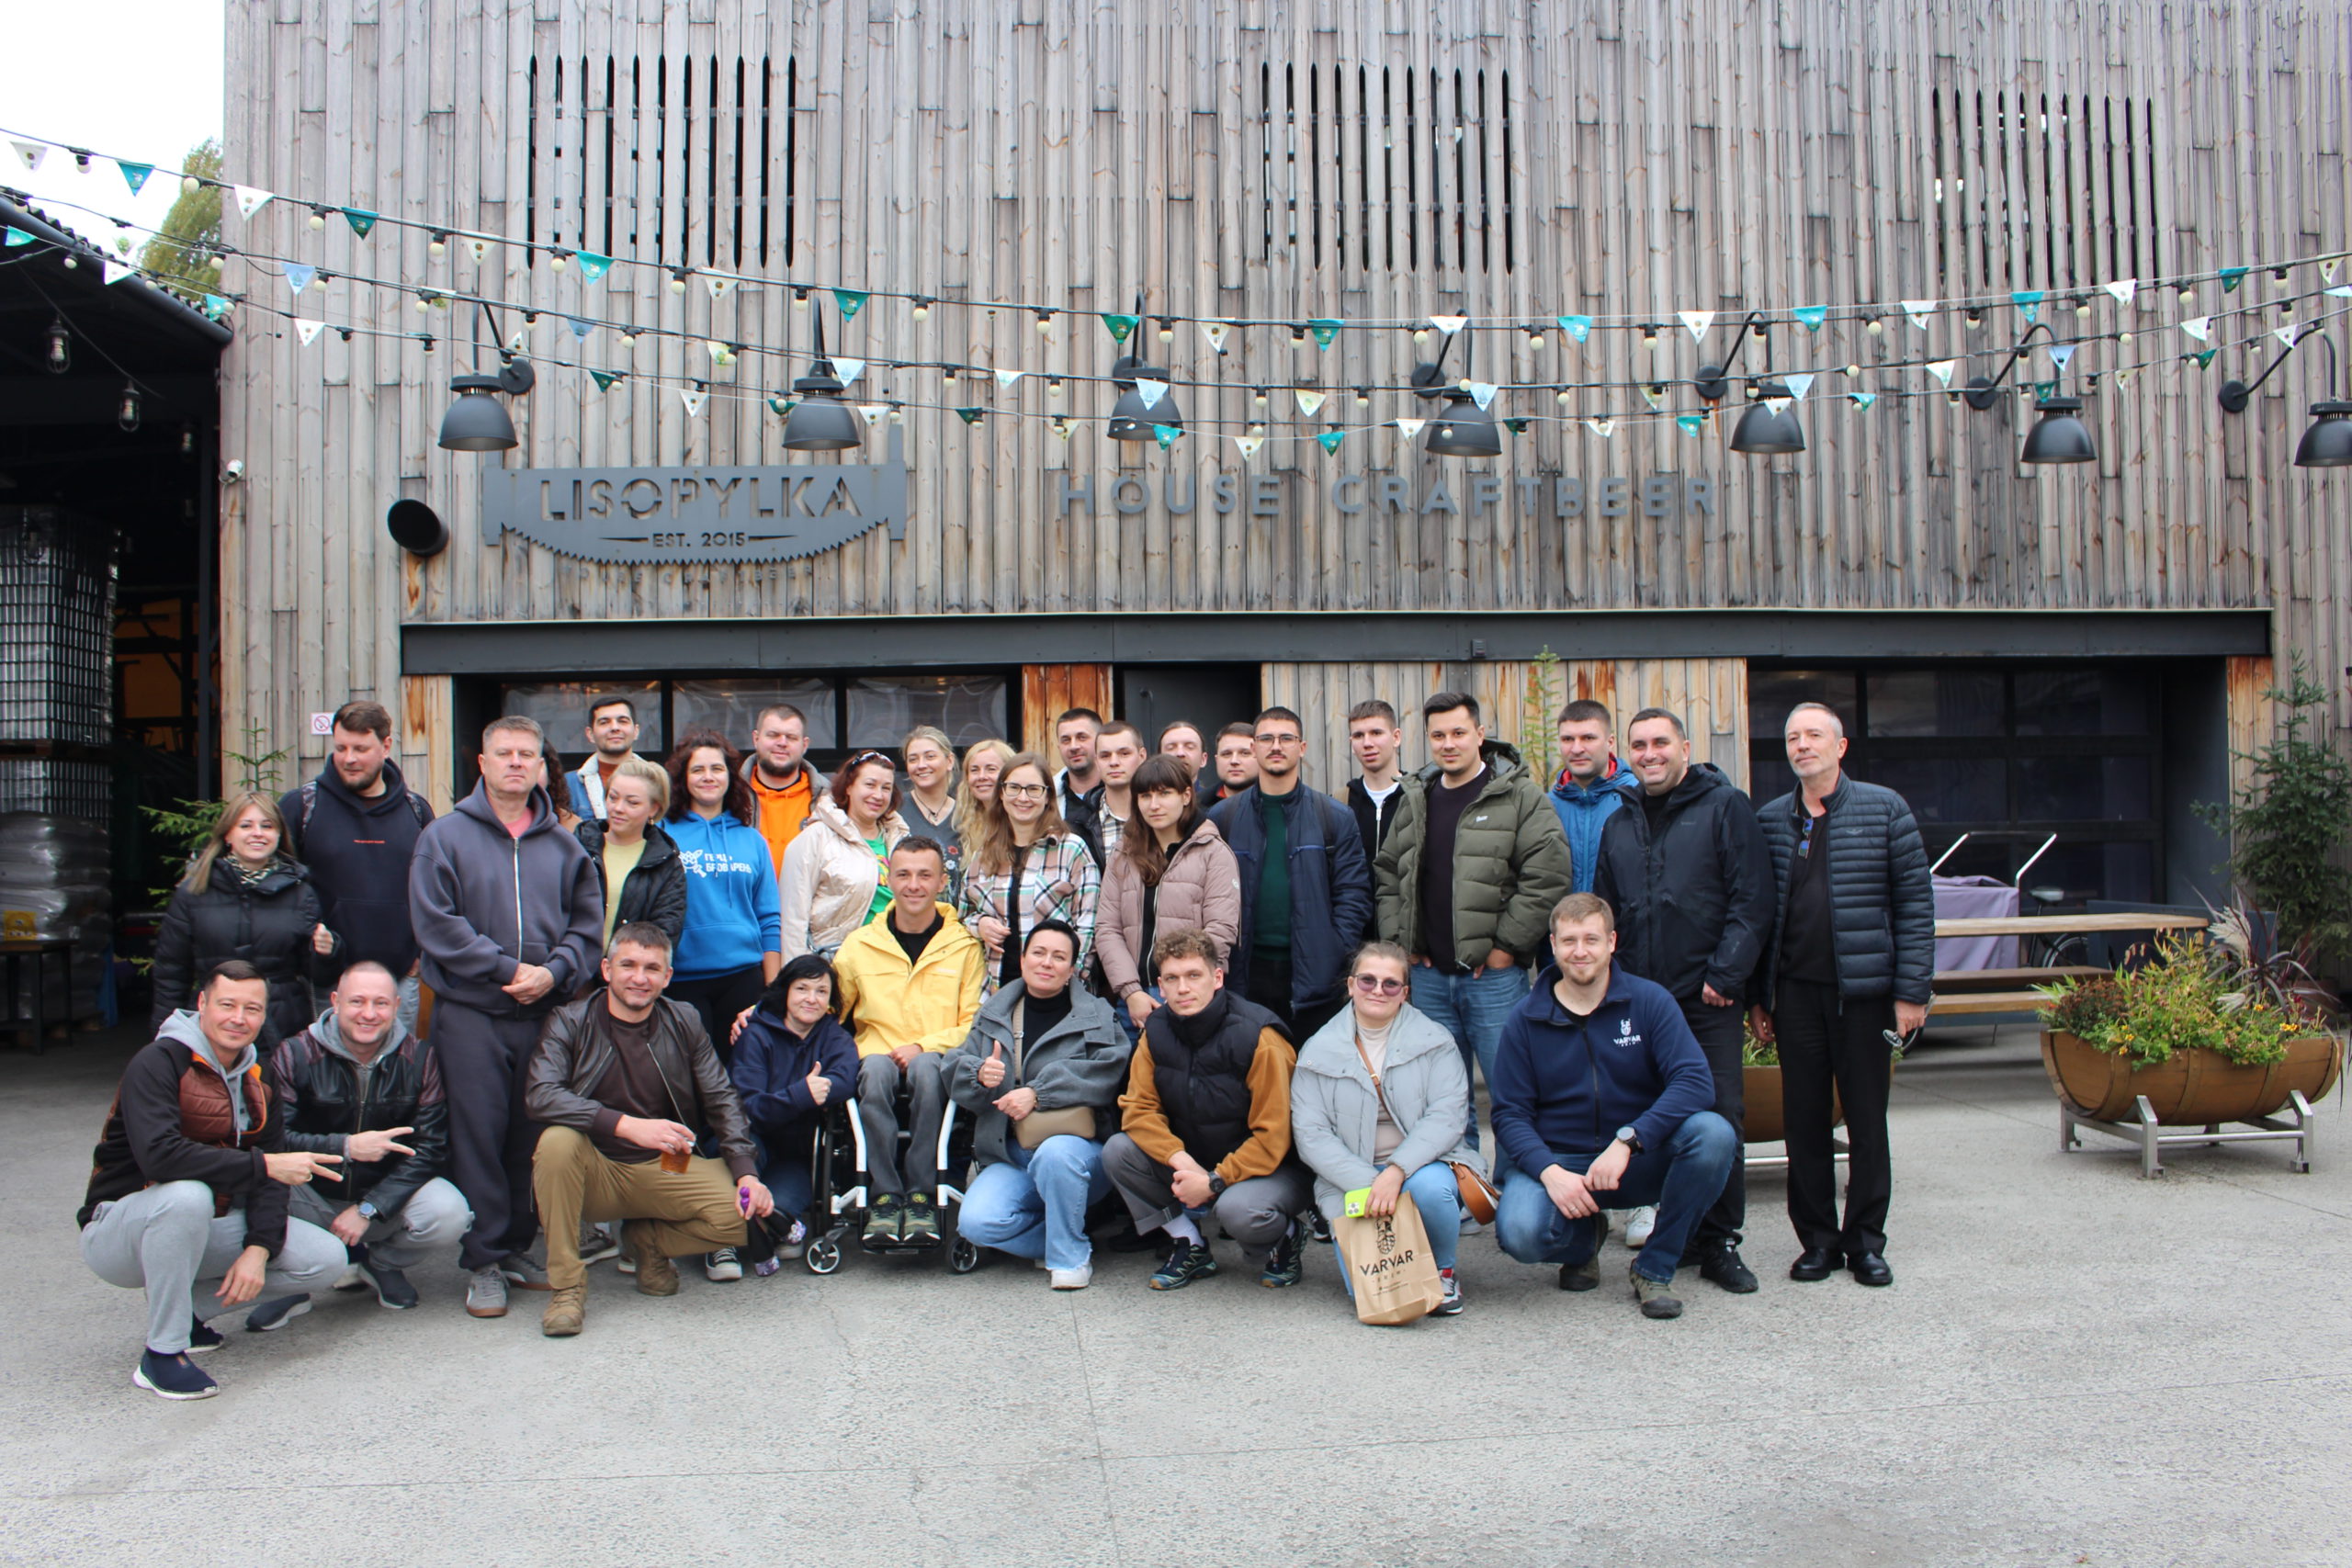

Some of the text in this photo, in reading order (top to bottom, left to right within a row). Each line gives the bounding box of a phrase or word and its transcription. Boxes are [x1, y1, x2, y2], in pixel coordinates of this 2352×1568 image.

[540, 476, 862, 520] LISOPYLKA
[1059, 474, 1280, 515] HOUSE
[652, 532, 746, 547] EST. 2015
[1360, 1249, 1414, 1276] VARVAR
